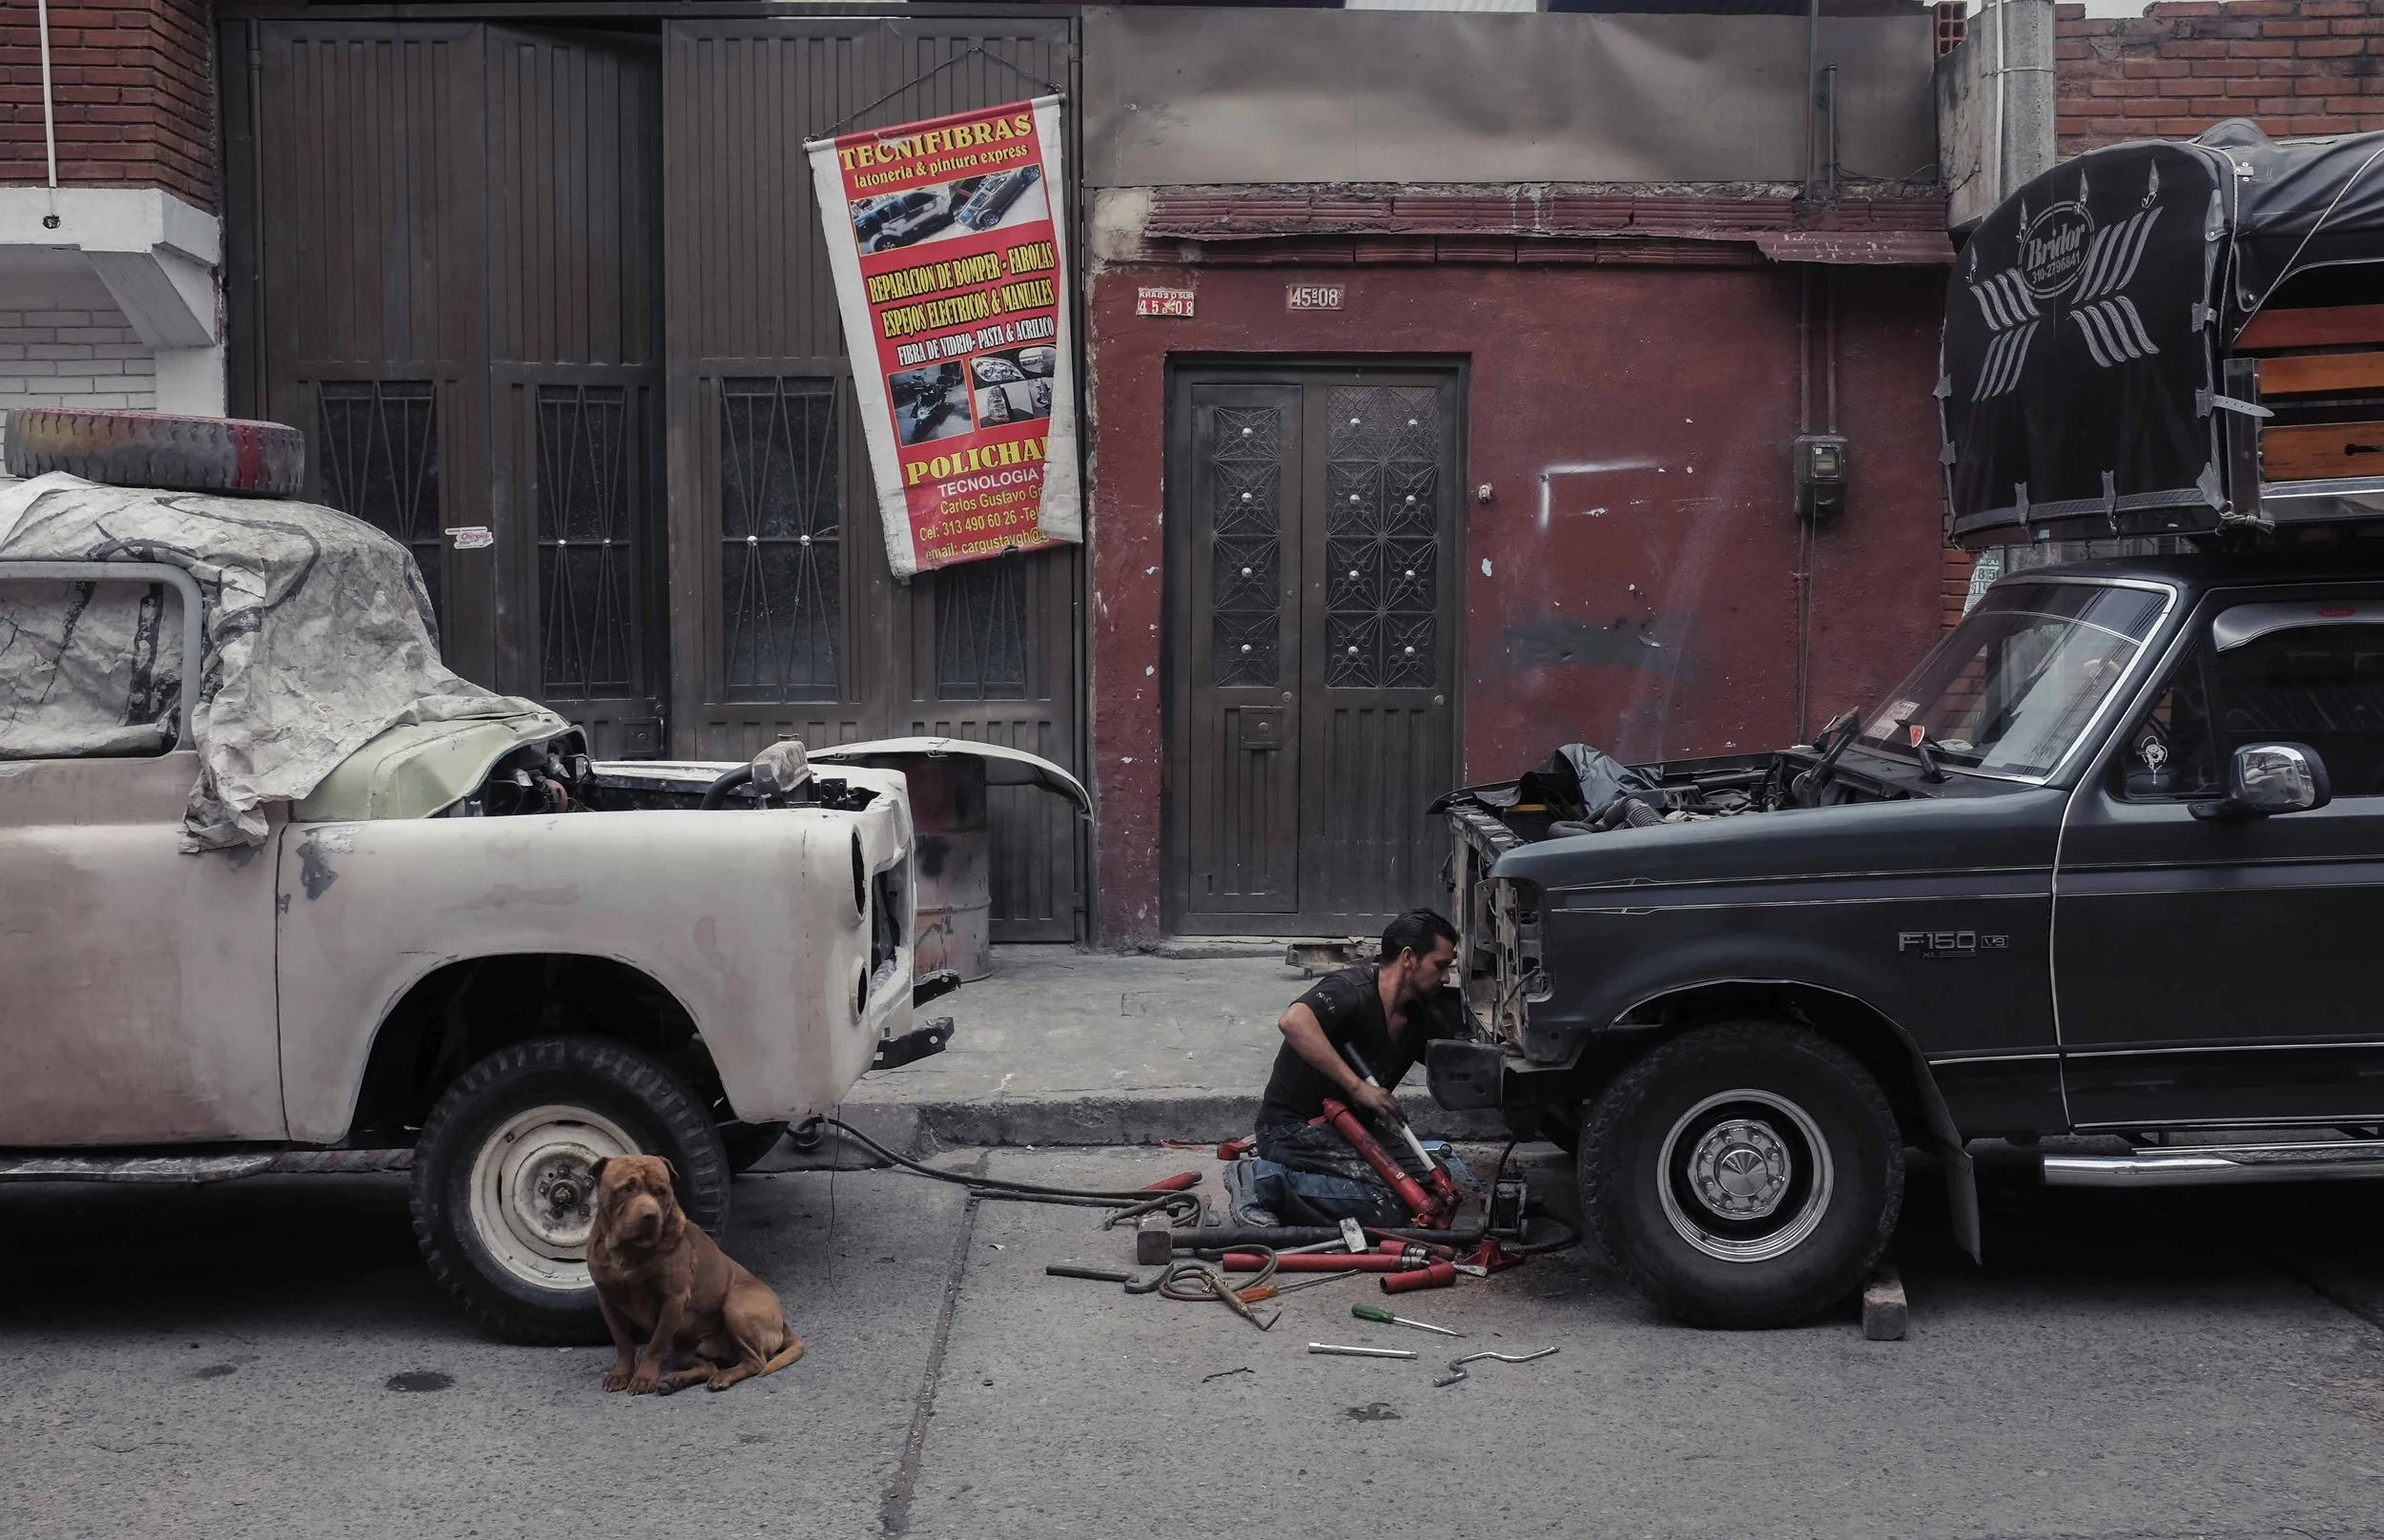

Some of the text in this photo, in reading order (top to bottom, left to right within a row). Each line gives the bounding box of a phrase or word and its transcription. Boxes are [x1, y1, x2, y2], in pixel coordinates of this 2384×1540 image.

[838, 113, 1034, 171] TECNIFIBRAS
[854, 143, 1028, 189] latoneria & pintura express
[2026, 222, 2086, 272] Bridor
[867, 264, 937, 303] REPARACION
[936, 261, 954, 290] DE
[953, 252, 1001, 287] BOMPER
[1007, 241, 1055, 276] FAROLAS
[881, 278, 1056, 339] ESPEJOS ELECTRICOS & MANUALES
[896, 340, 927, 366] FIBRA
[926, 338, 941, 360] DE
[976, 325, 1005, 350] PASTA
[1005, 322, 1015, 343] &
[1015, 316, 1055, 341] ACRILICO
[937, 466, 1039, 498] TECNOLOGIA
[940, 497, 976, 516] Carlos
[979, 487, 1026, 508] Gustavo
[919, 524, 940, 542] Cel:
[942, 518, 962, 537] 313
[965, 515, 985, 531] 490
[987, 512, 1001, 527] 60
[1003, 508, 1017, 525] 26
[925, 543, 958, 562] email:
